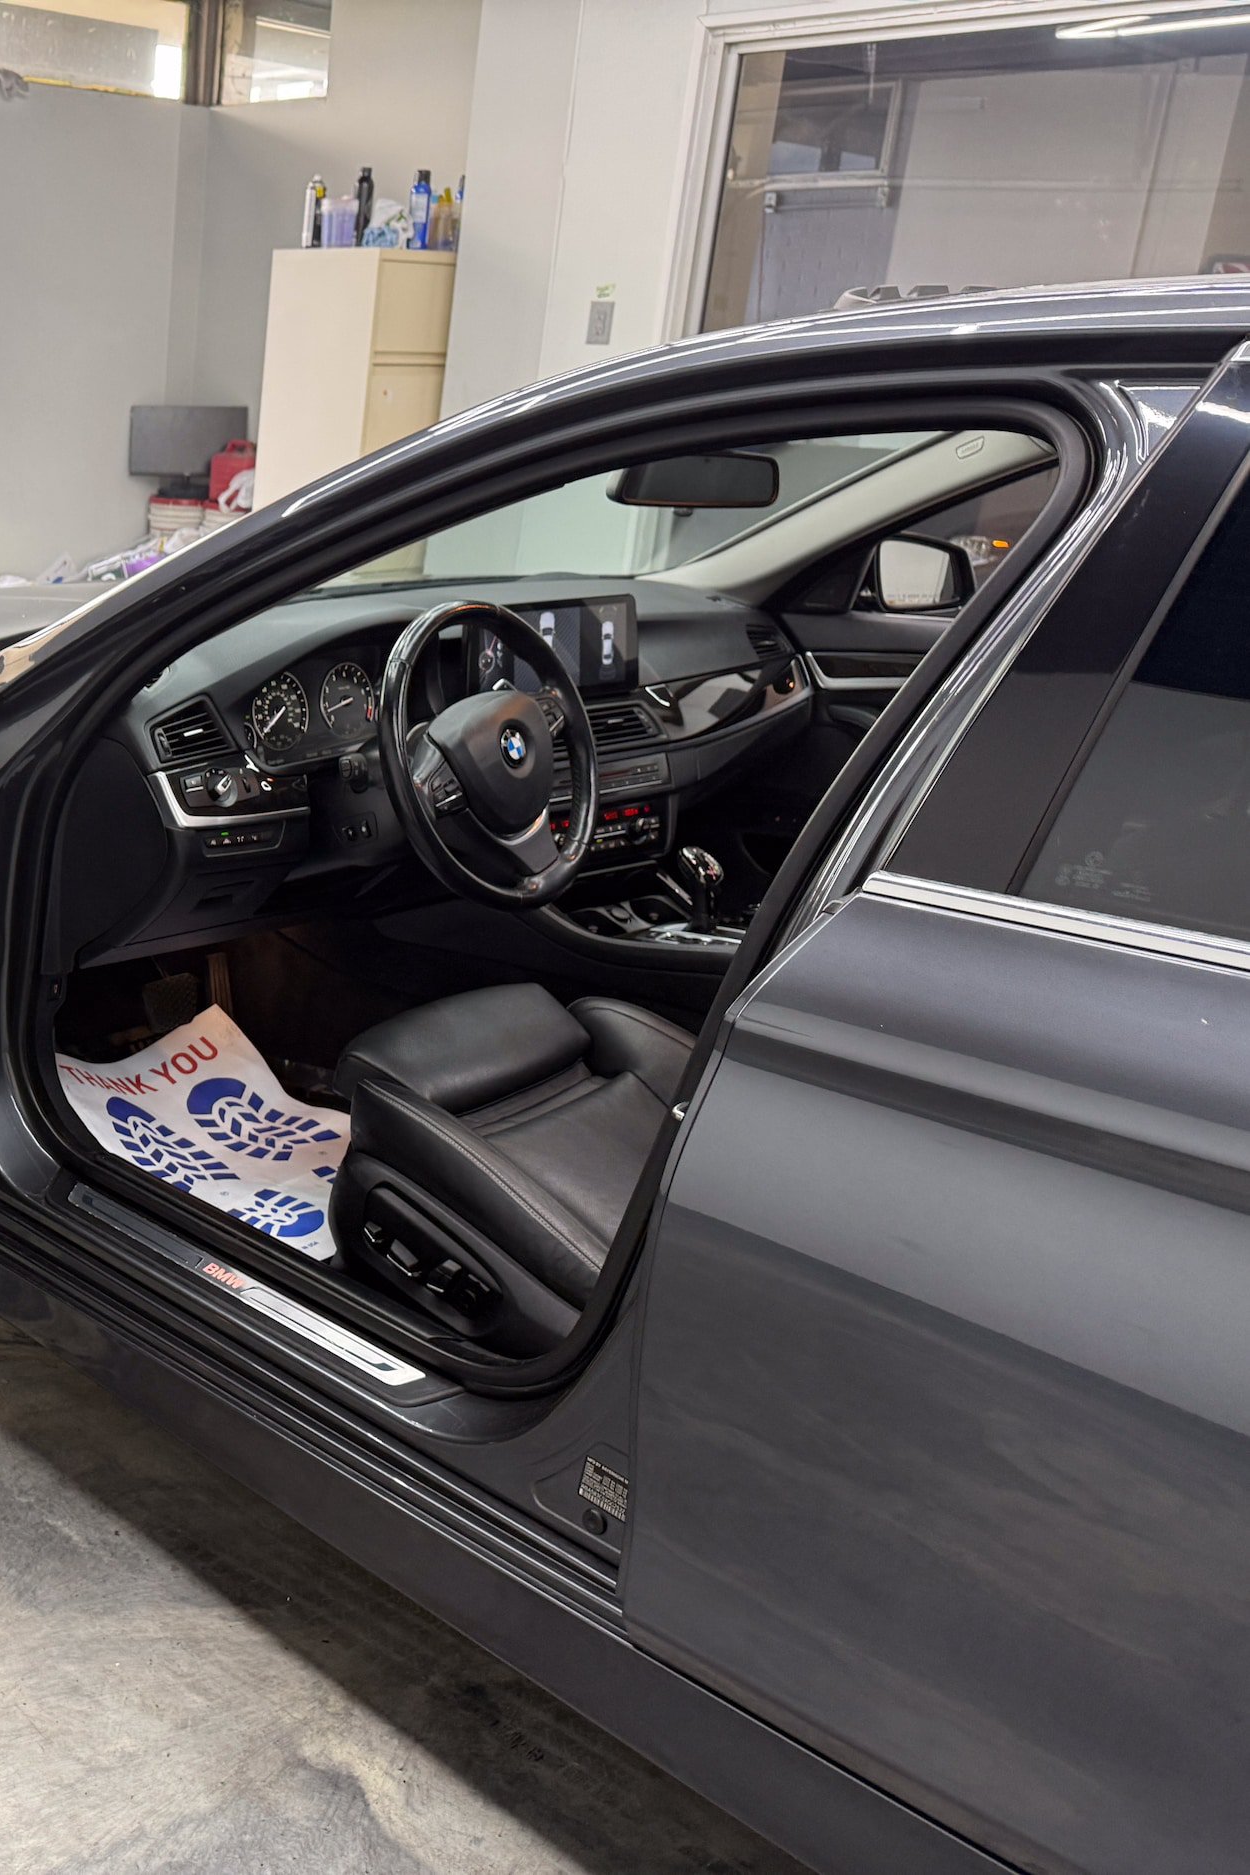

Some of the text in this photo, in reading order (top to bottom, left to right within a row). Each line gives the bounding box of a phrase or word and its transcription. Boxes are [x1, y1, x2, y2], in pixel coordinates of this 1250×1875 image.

[59, 1036, 218, 1096] THANK YOU
[202, 1262, 244, 1289] BMW
